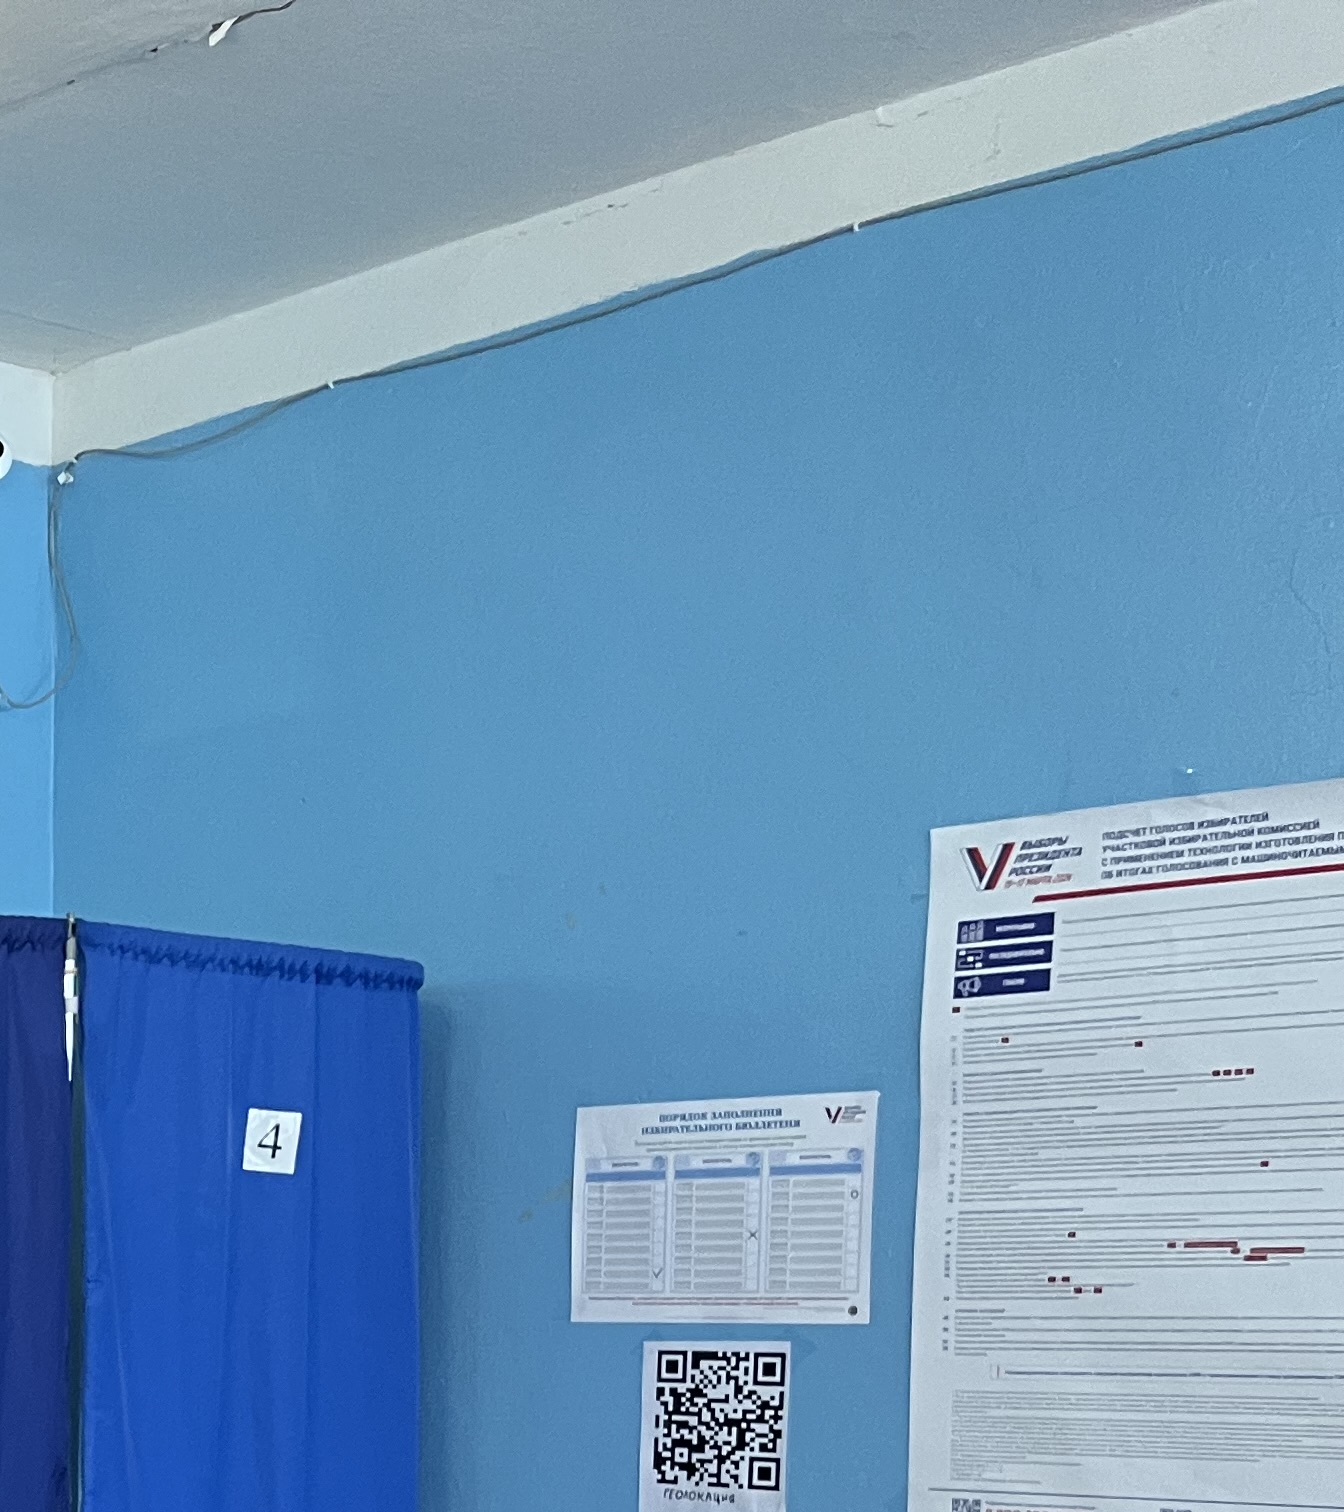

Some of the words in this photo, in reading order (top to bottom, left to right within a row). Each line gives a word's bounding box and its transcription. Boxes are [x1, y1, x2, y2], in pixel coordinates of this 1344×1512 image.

[1102, 836, 1166, 853] УЧАСТКОВОЙ
[1168, 826, 1255, 846] ИЗБИРАТЕЛЬНОЙ
[1257, 818, 1321, 836] КОМИССИЕЙ
[1150, 821, 1195, 836] ГОЛОСОВ
[1197, 811, 1269, 828] ИЗБИРАТЕЛЕЙ
[1101, 857, 1108, 867] С
[1187, 842, 1253, 858] ТЕХНОЛОГИИ
[1255, 832, 1335, 849] ИЗГОТОВЛЕНИЯ
[1155, 857, 1229, 874] ГОЛОСОВАНИЯ
[1231, 856, 1239, 866] С
[257, 1122, 283, 1159] 4
[663, 1487, 736, 1505] ГЕОЛОКАЦИЯ
